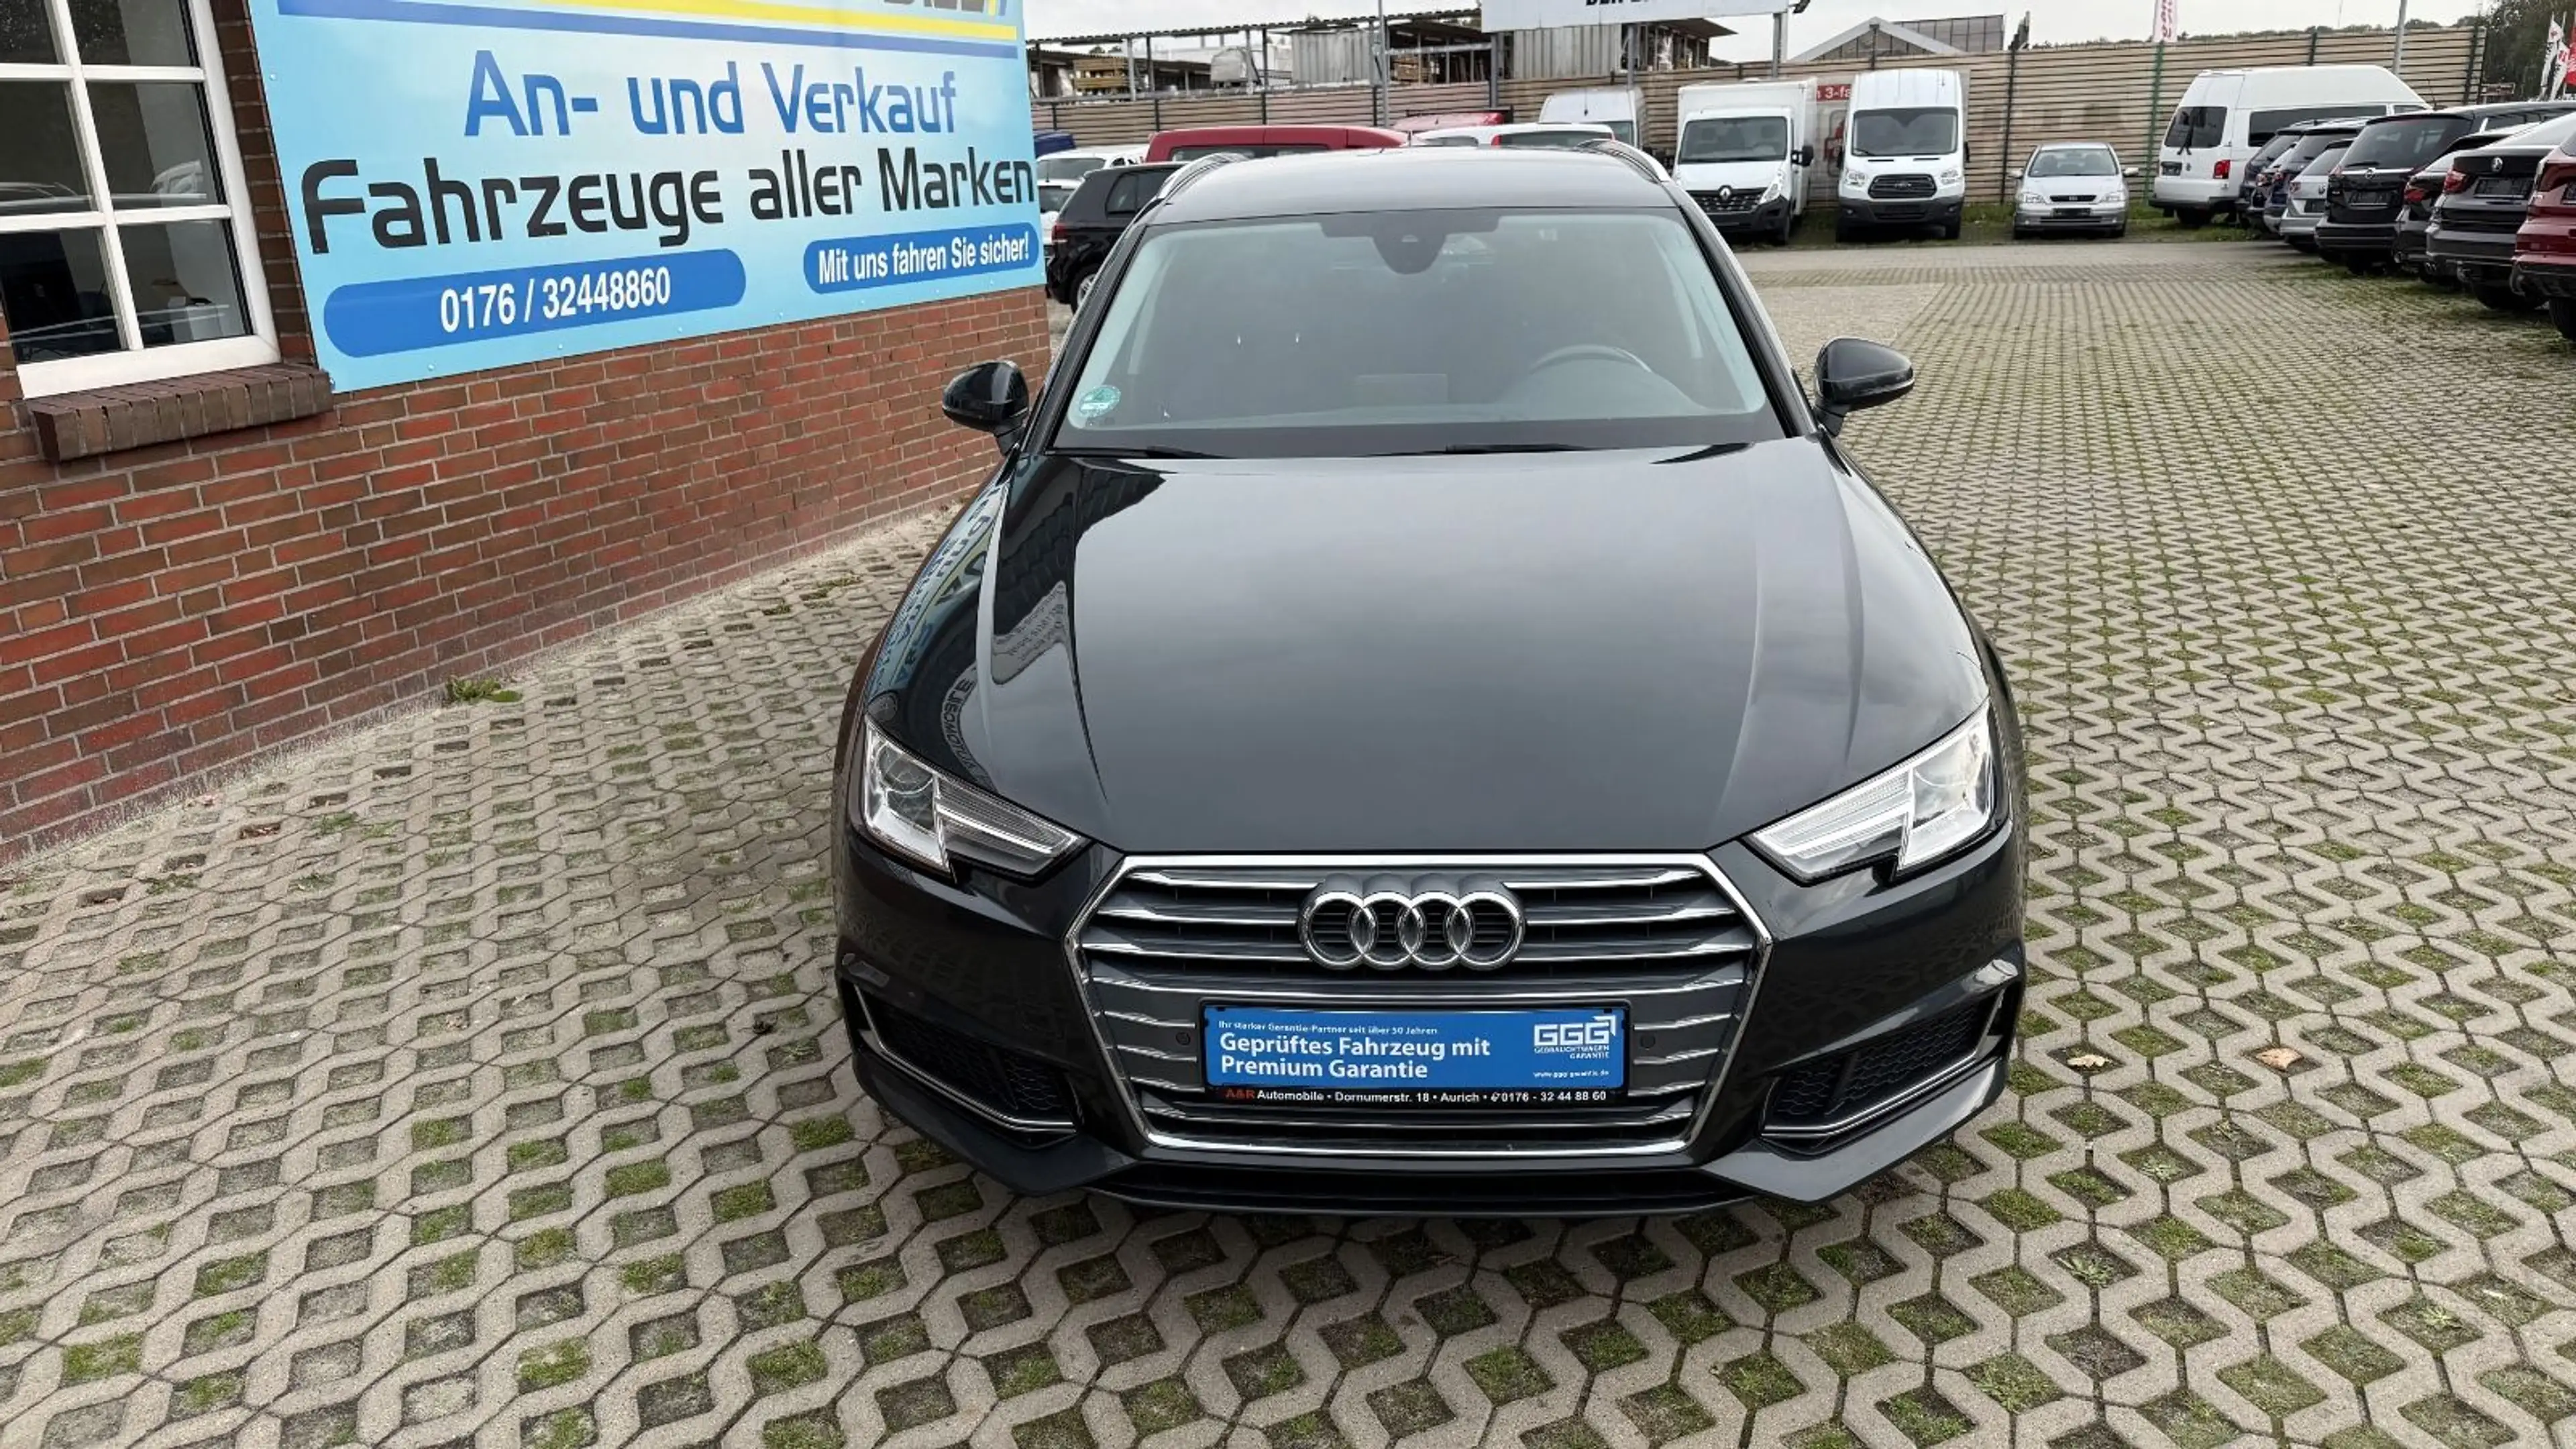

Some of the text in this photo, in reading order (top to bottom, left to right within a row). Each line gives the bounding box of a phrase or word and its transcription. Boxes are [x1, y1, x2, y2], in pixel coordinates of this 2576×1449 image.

[465, 52, 957, 137] An- und Verkauf
[301, 146, 1035, 254] Fahrzeuge aller Marken
[818, 231, 1030, 284] Mit uns fahren Sie sicher!
[441, 285, 516, 333] 0176
[543, 266, 671, 319] 32448860
[1220, 1032, 1491, 1060] Geprüftes Fahrzeug mit
[1534, 1022, 1609, 1046] GGG
[1221, 1055, 1428, 1079] Premium Garantie
[1225, 1088, 1255, 1099] A&R
[1256, 1089, 1325, 1102] Automobile
[1334, 1091, 1413, 1102] Dornumerstr.
[1416, 1092, 1429, 1102] 18
[1441, 1091, 1479, 1102] Aurich
[1540, 1091, 1555, 1102] 32
[1557, 1091, 1572, 1101] 44
